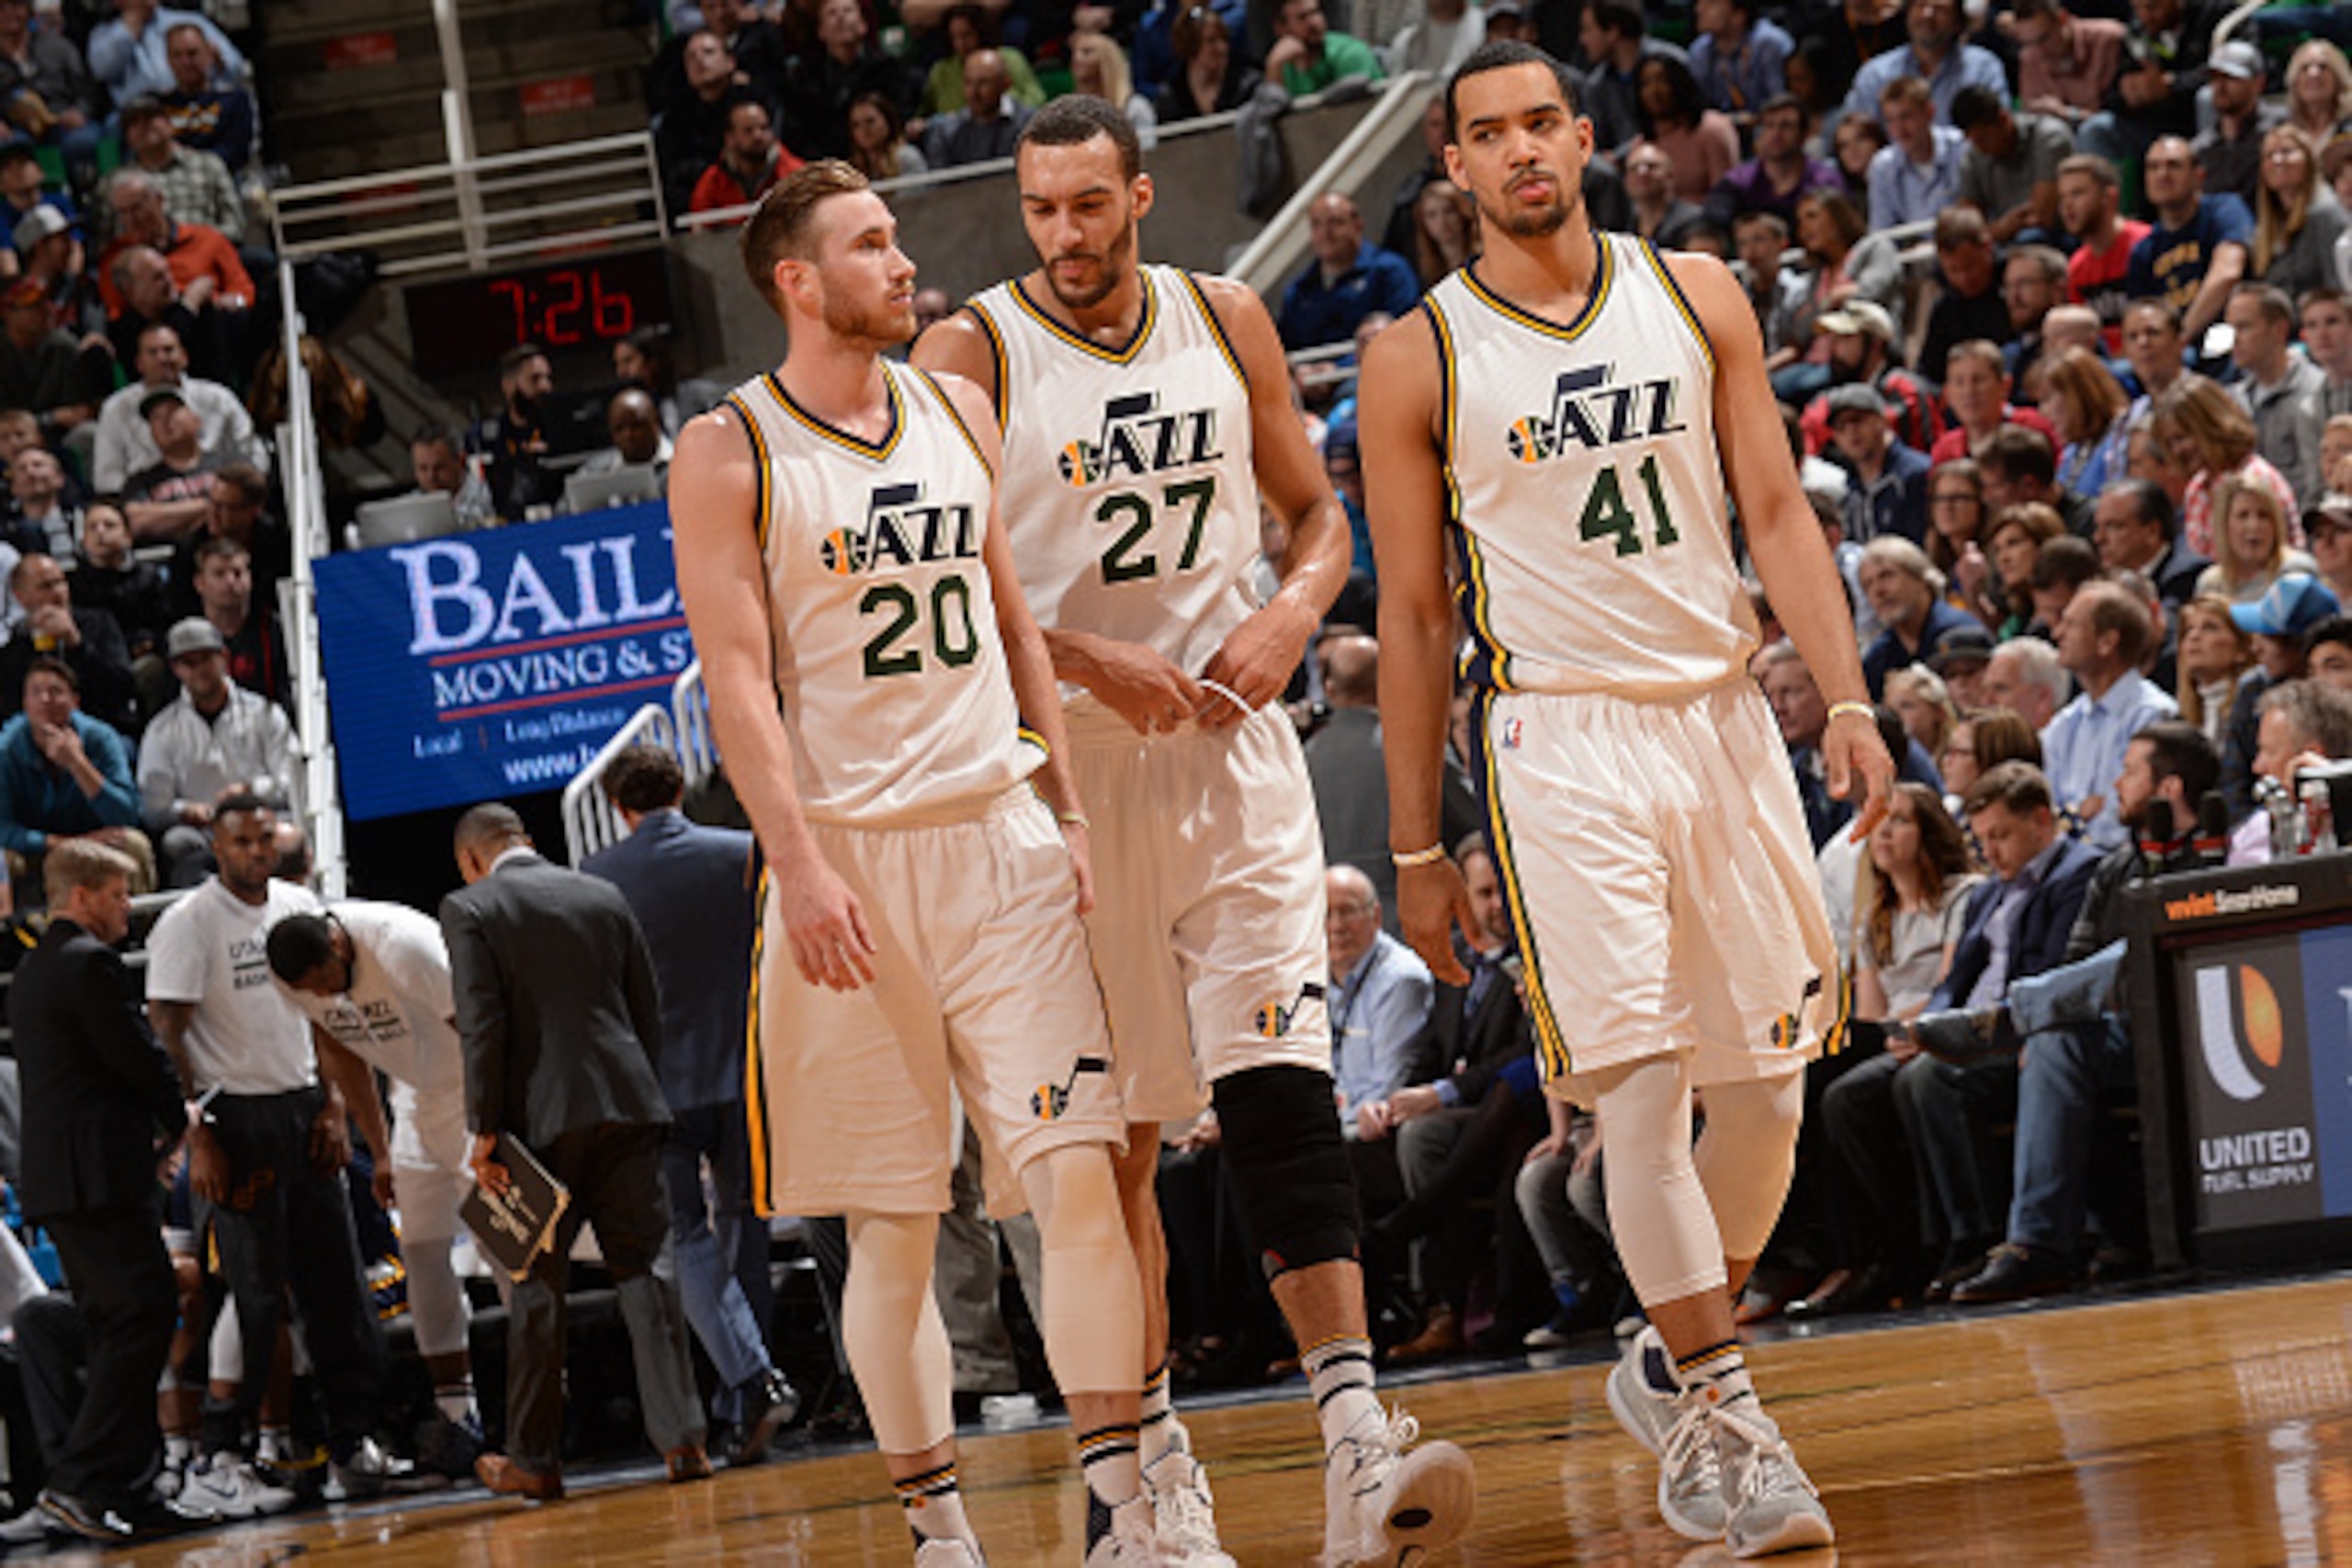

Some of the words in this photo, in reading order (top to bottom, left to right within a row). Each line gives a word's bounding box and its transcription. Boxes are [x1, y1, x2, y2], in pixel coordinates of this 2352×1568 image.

[488, 265, 637, 345] 7:26
[1057, 389, 1225, 487] JAZZ
[1507, 360, 1687, 464] JAZZ
[820, 480, 979, 576] JAZZ
[1094, 476, 1216, 585] 27
[1577, 454, 1679, 558] 41
[389, 527, 686, 655] BAIL
[859, 574, 980, 678] 20
[431, 644, 609, 709] MOVING
[616, 639, 656, 678] &
[659, 627, 693, 671] S
[2199, 1126, 2312, 1171] UNITED
